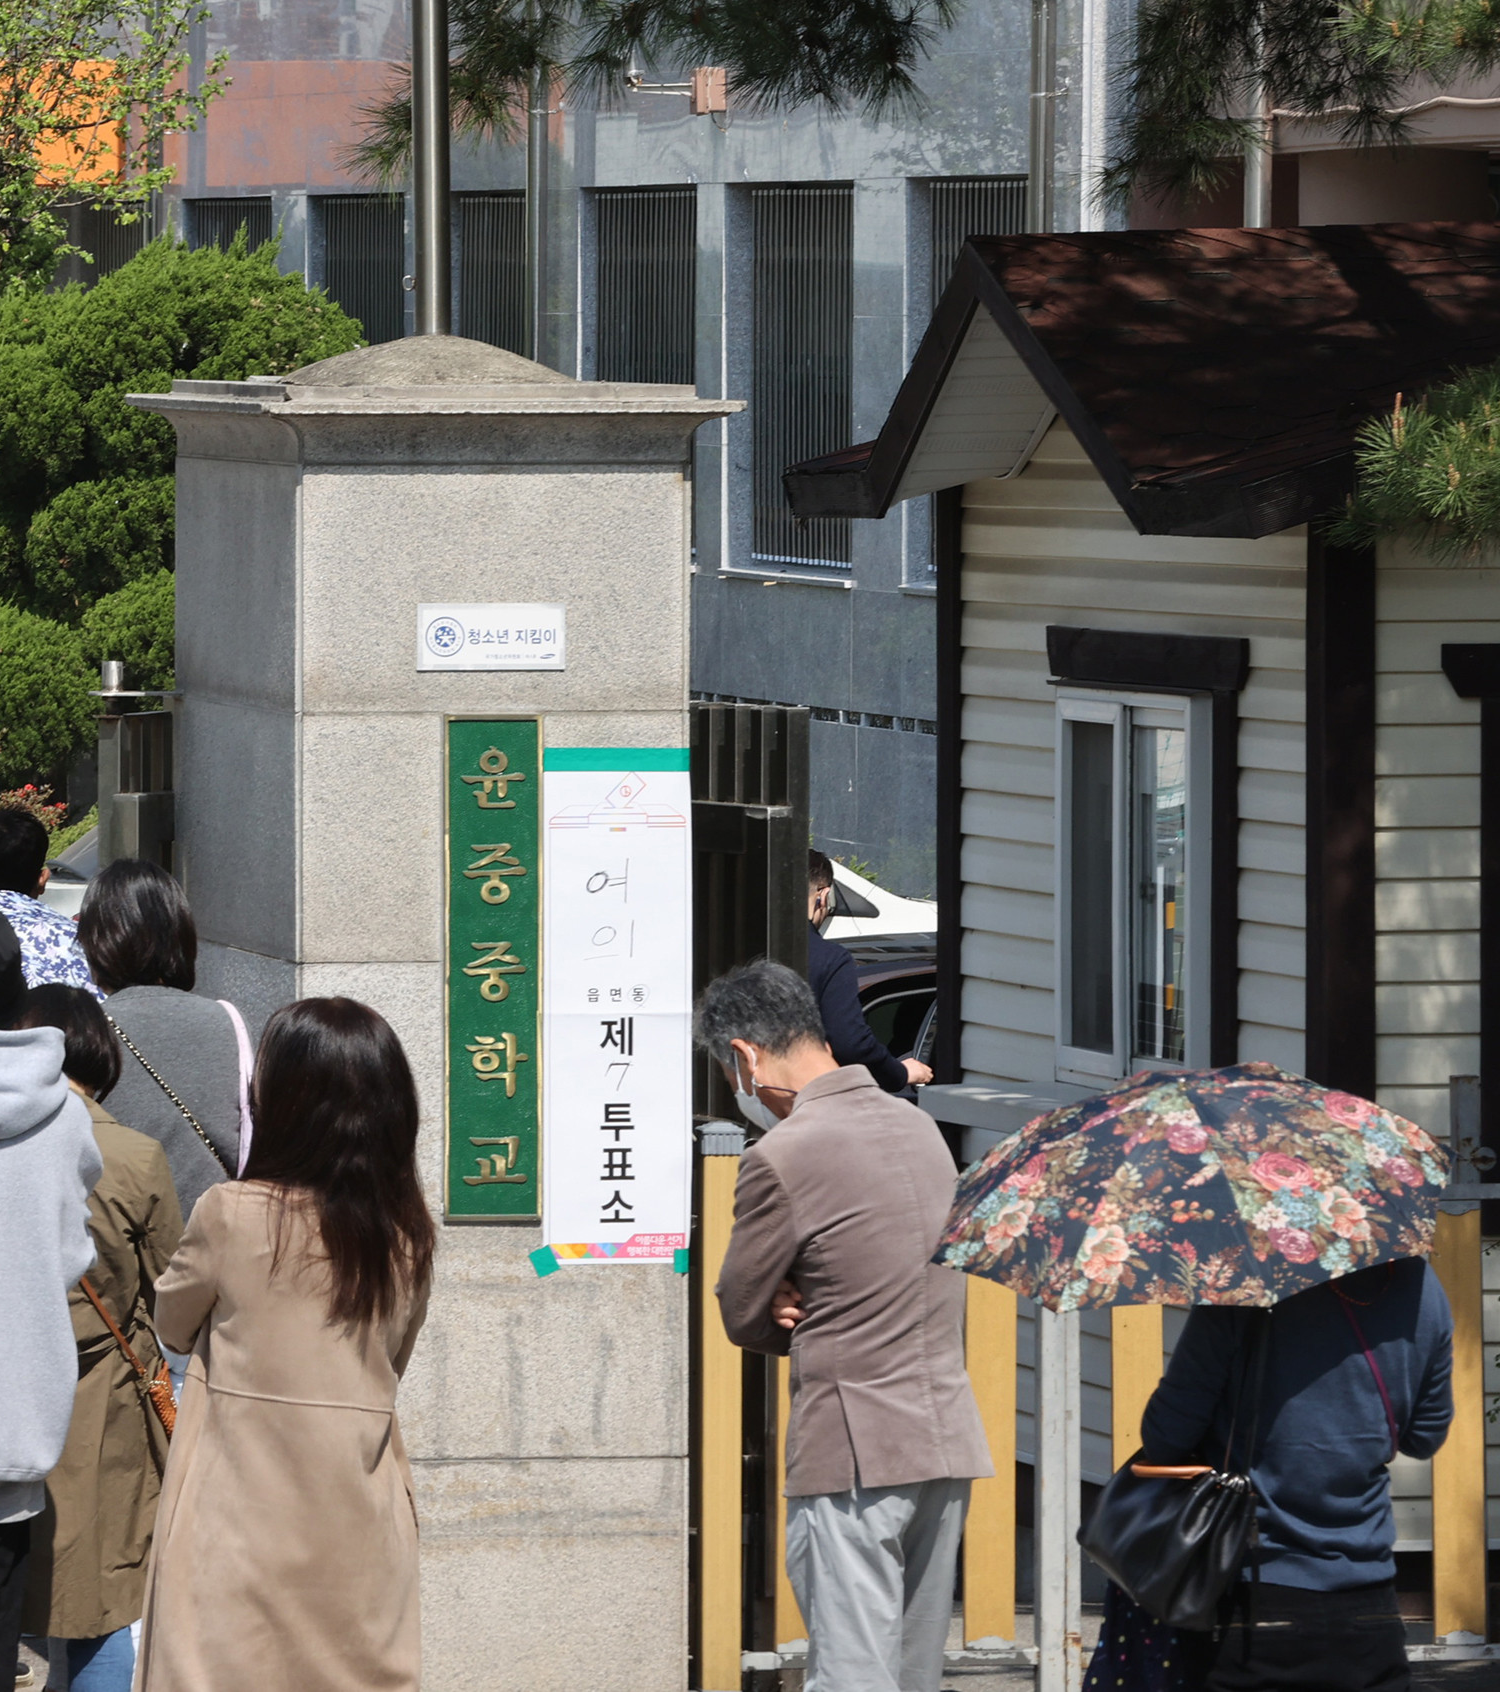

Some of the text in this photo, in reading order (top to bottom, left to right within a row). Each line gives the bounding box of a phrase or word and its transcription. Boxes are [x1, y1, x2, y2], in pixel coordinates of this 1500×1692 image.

[468, 628, 509, 645] 청소년
[515, 628, 556, 645] 지킴이
[460, 745, 529, 1187] 윤중중학교
[587, 987, 646, 1003] 읍 면 동
[635, 1235, 683, 1245] 아름다운 선거
[627, 1245, 682, 1256] 행복한 대한민
